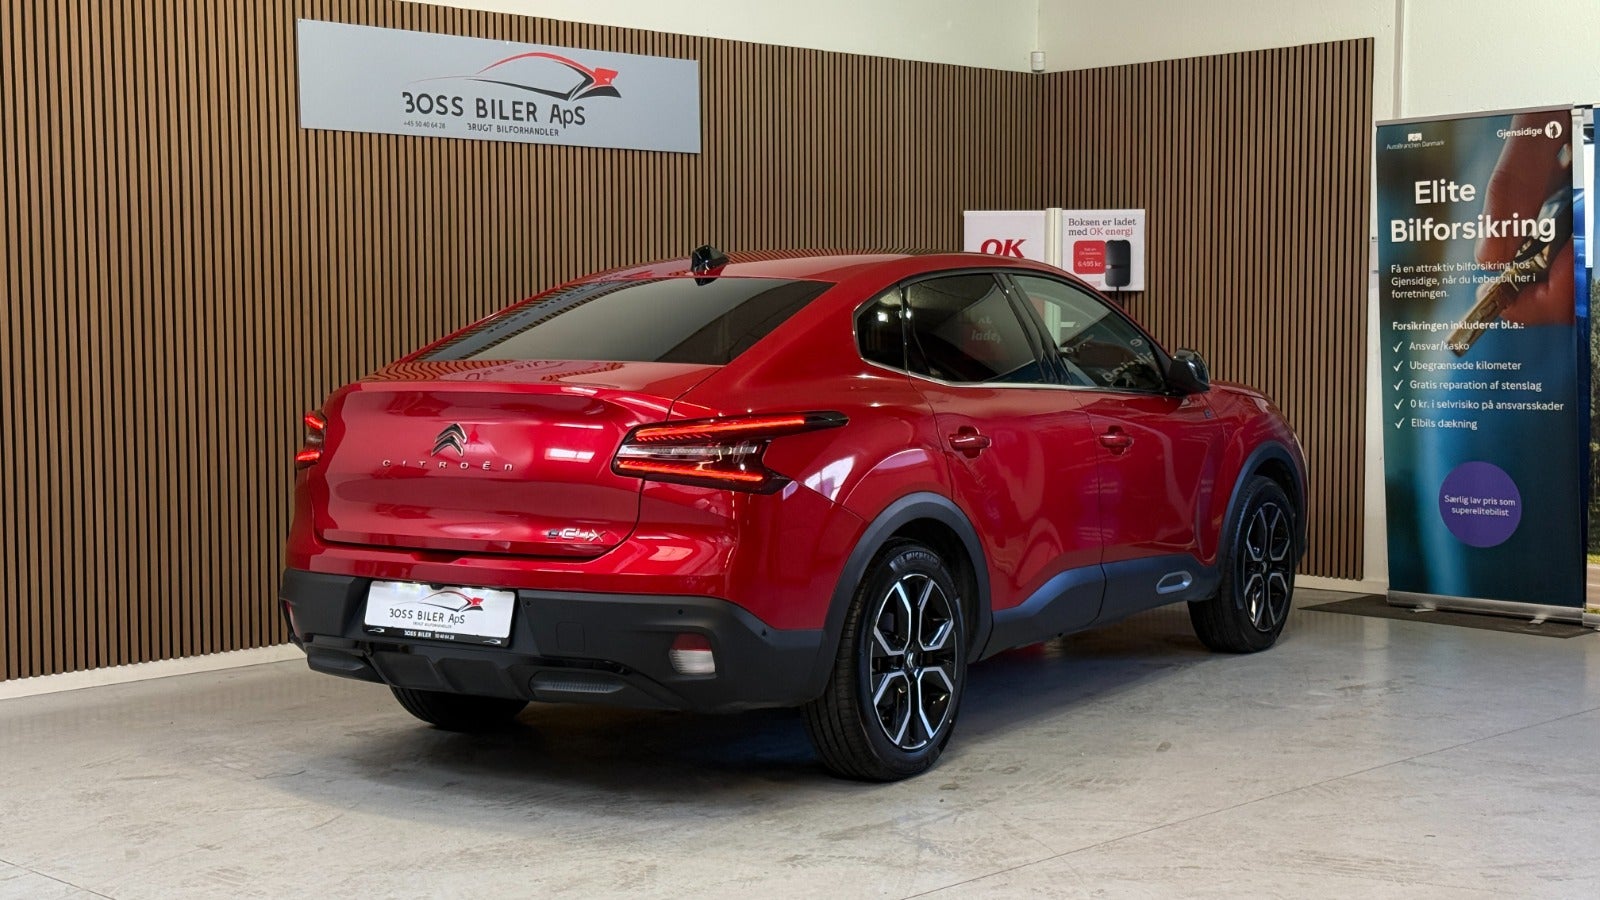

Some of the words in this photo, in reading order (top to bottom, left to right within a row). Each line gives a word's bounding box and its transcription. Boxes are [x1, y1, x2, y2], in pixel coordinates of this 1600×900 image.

[476, 98, 538, 122] BILER
[550, 104, 586, 129] ApS
[496, 125, 559, 136] BILFORHANDLER
[1496, 128, 1542, 139] Gjensidige
[1414, 178, 1476, 204] Elite
[1068, 218, 1100, 226] Boksen
[1114, 218, 1136, 226] ladet
[1090, 227, 1104, 235] OK
[1105, 227, 1133, 237] energi
[1391, 213, 1556, 243] Bilforsikring
[1391, 264, 1401, 273] Få
[1416, 264, 1454, 272] attraktiv
[1456, 262, 1510, 272] bilforsikring
[1513, 261, 1530, 270] hos
[1391, 277, 1440, 287] Gjensidige,
[1442, 275, 1456, 284] når
[1459, 275, 1470, 284] du
[1472, 275, 1500, 284] køber
[1500, 274, 1512, 283] bil
[1515, 274, 1530, 283] her
[1392, 289, 1449, 299] forretningen.
[1392, 321, 1448, 332] Forsikringen
[1450, 320, 1499, 330] inkluderer
[1501, 320, 1524, 329] bl.a.:
[1409, 341, 1470, 351] Ansvar/kasko
[1409, 361, 1474, 371] Ubegrænsede
[1476, 361, 1522, 370] kilometer
[1410, 380, 1437, 390] Gratis
[1439, 381, 1487, 391] reparation
[1489, 380, 1499, 390] af
[1501, 381, 1542, 392] stenslag
[1410, 400, 1416, 408] 0
[1418, 400, 1430, 408] kr.
[1436, 401, 1480, 409] selvrisiko
[1482, 400, 1494, 411] på
[1496, 402, 1564, 411] ansvarsskader
[1411, 419, 1435, 428] Elbils
[1438, 420, 1477, 430] dækning
[1444, 494, 1469, 505] Særlig
[1483, 497, 1498, 506] pris
[1452, 507, 1509, 517] superelitebilist
[417, 610, 444, 622] BILER
[448, 613, 465, 625] ApS
